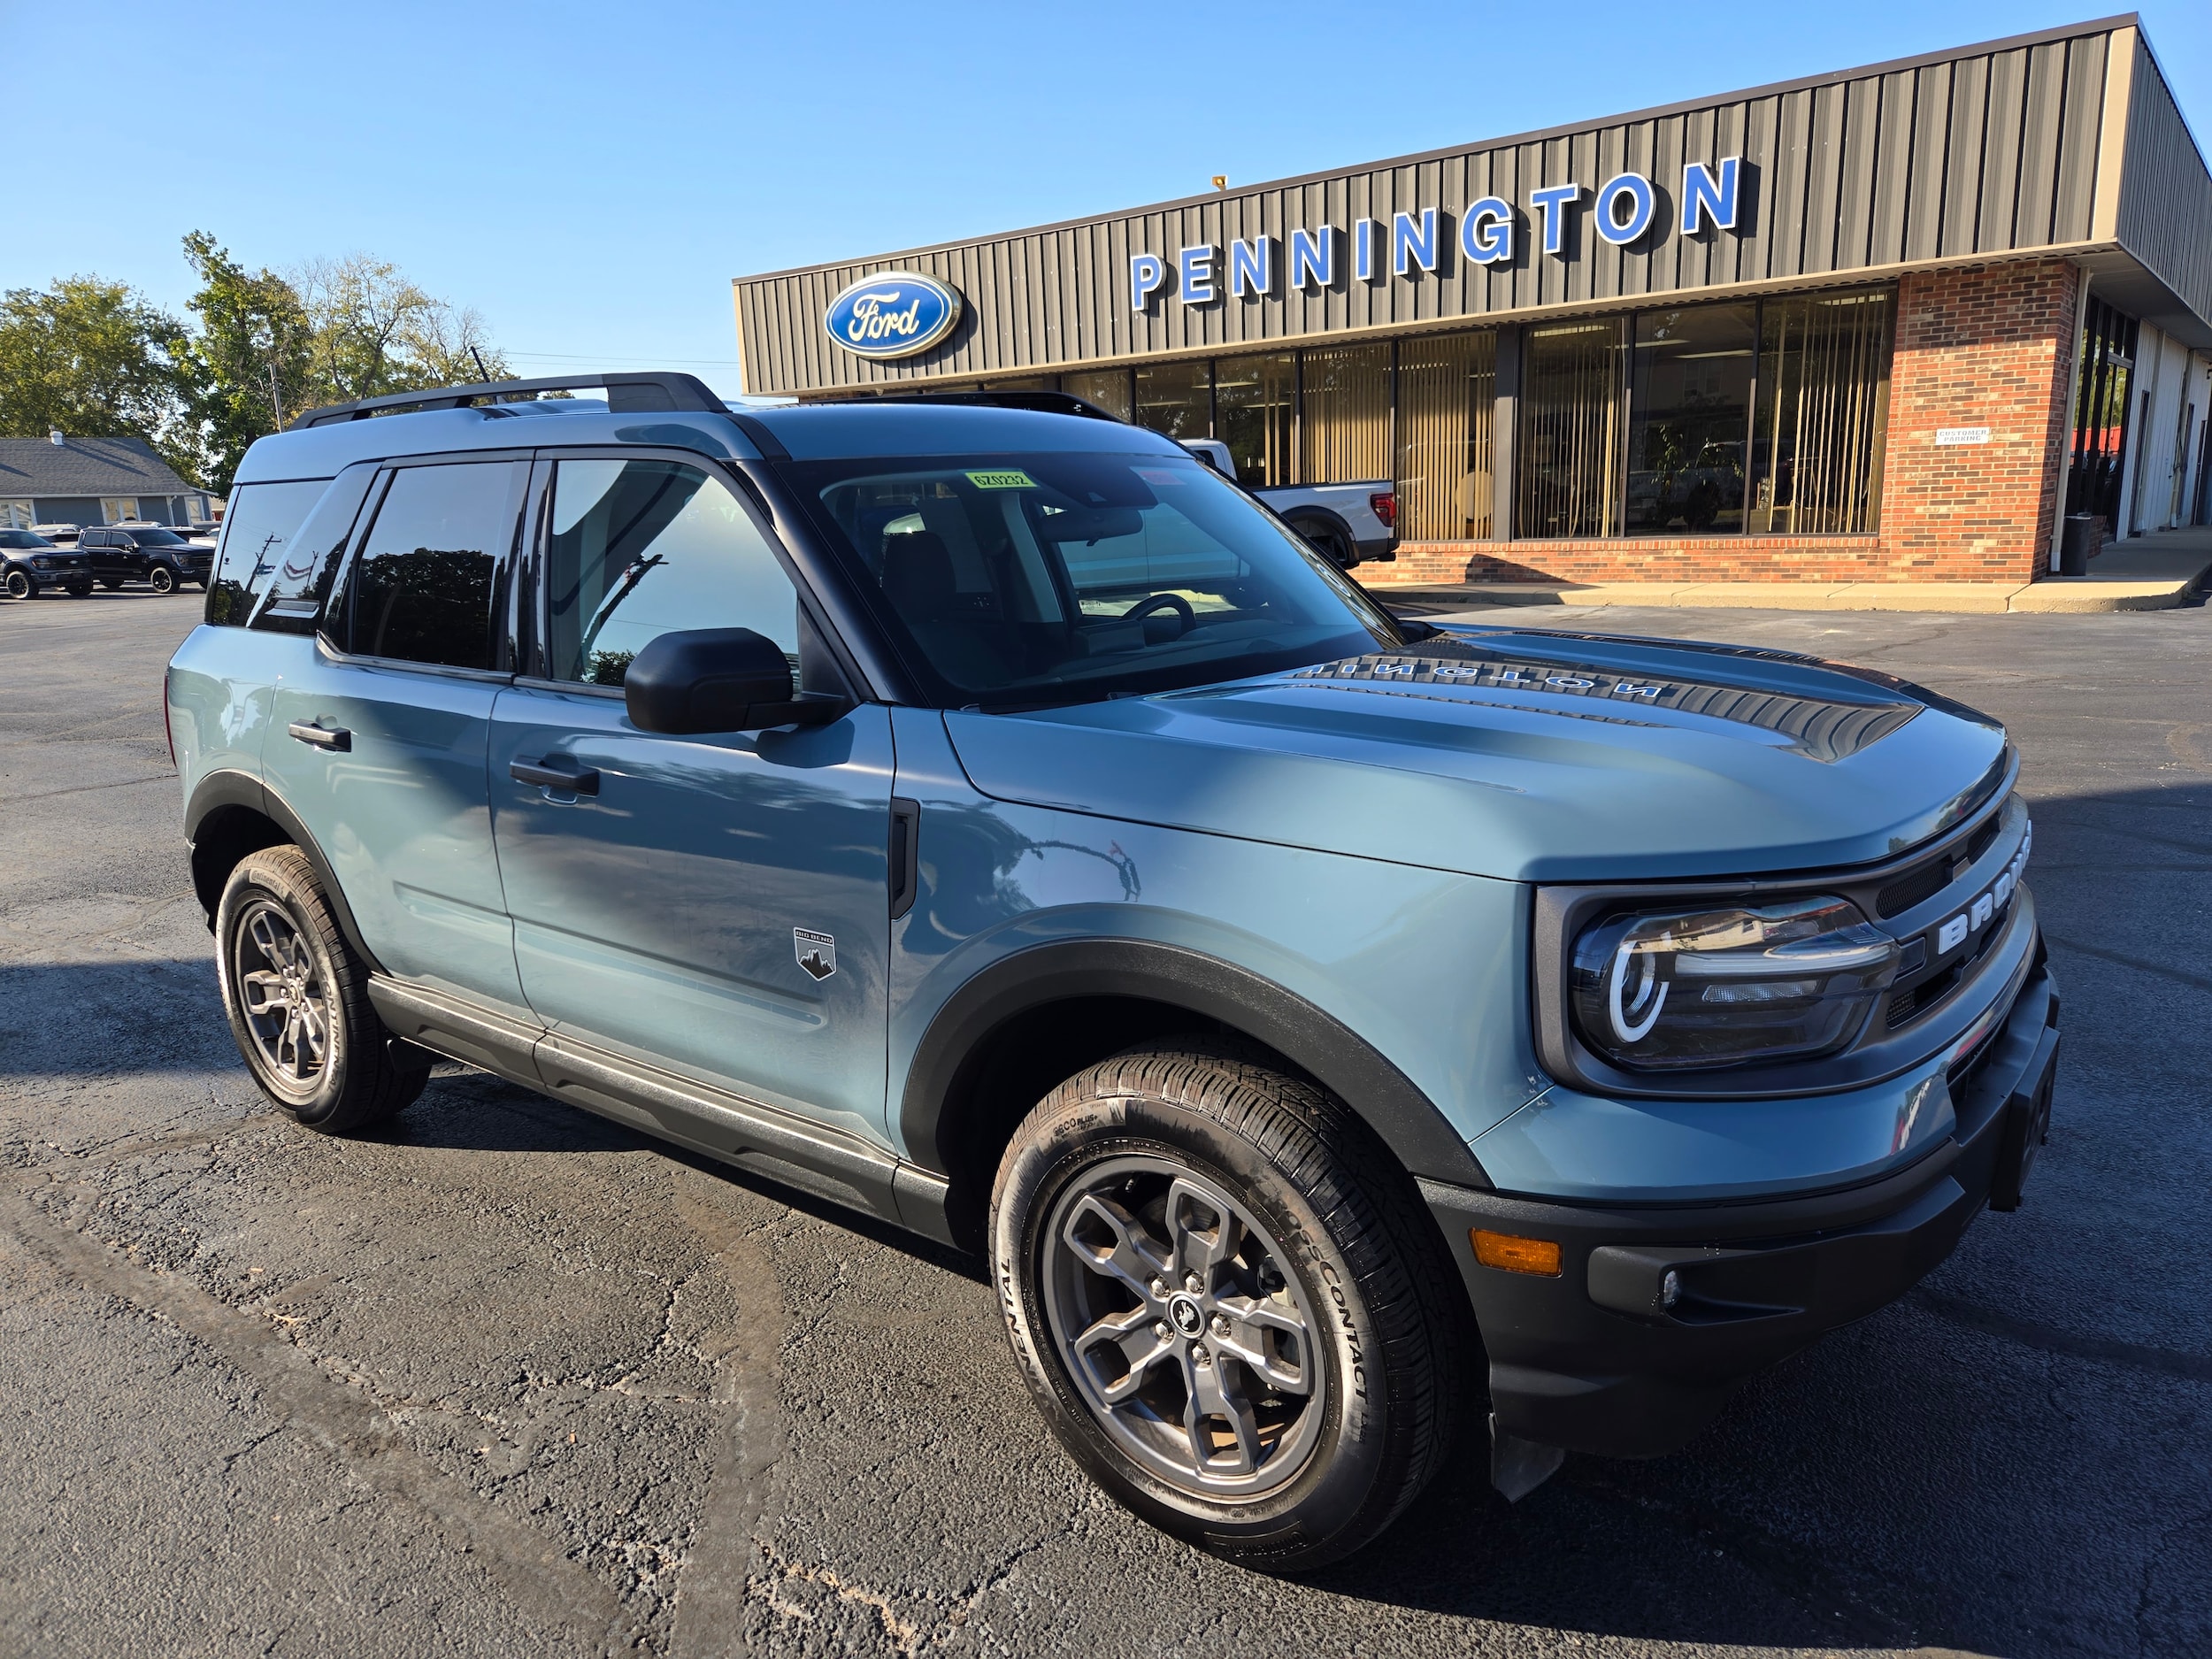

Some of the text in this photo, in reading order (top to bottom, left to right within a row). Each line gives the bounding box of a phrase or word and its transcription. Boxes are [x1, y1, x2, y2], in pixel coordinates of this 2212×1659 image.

[1130, 155, 1741, 311] PENNINGTON
[848, 291, 921, 342] Ford
[974, 475, 1028, 486] 6Z0232
[796, 930, 833, 944] BIG BEND
